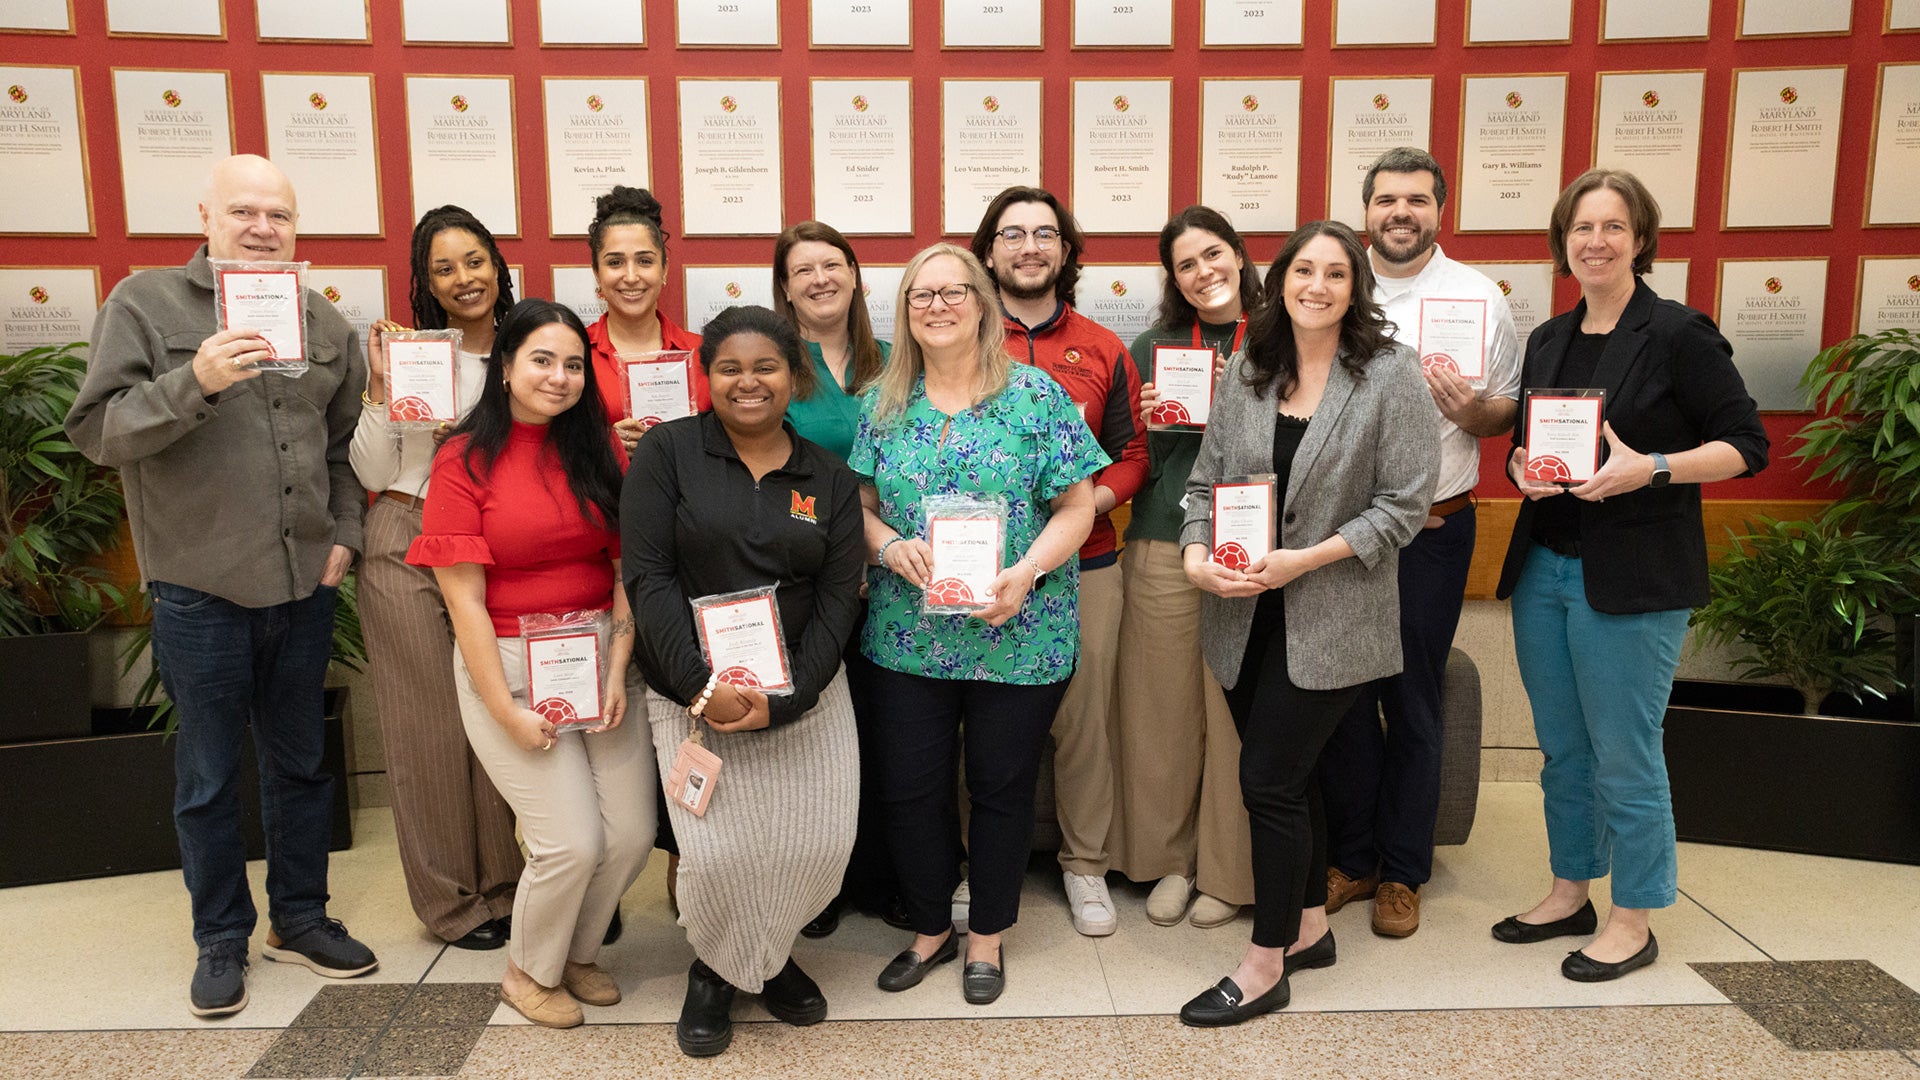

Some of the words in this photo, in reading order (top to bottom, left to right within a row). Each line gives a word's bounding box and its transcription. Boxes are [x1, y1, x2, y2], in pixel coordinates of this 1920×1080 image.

[0, 110, 51, 119] ARYLAND
[145, 113, 204, 123] MARYLAND
[1488, 115, 1540, 123] MARYLAND
[1623, 113, 1677, 122] MARYLAND
[1760, 111, 1816, 120] MARYLAND
[292, 117, 348, 125] MARYLAND
[434, 119, 488, 127] MARYLAND
[704, 119, 756, 127] MARYLAND
[1356, 117, 1407, 125] MARYLAND
[31, 124, 61, 133] SMITH
[138, 126, 170, 136] ROBERT
[184, 128, 212, 137] SMITH
[1480, 128, 1508, 136] ROBERT
[1521, 127, 1546, 135] SMITH
[1615, 127, 1644, 136] ROBERT
[1657, 126, 1682, 135] SMITH
[1752, 124, 1782, 133] ROBERT
[1795, 123, 1822, 132] SMITH
[285, 130, 316, 138] ROBERT
[330, 130, 357, 139] SMITH
[427, 132, 456, 140] ROBERT
[469, 132, 495, 140] SMITH
[605, 132, 631, 140] SMITH
[698, 132, 726, 140] ROBERT
[738, 132, 763, 140] SMITH
[829, 131, 857, 139] ROBERT
[869, 131, 894, 139] SMITH
[1090, 131, 1117, 139] ROBERT
[1258, 130, 1282, 138] SMITH
[1348, 130, 1376, 138] ROBERT
[1389, 129, 1413, 137] SMITH
[1887, 298, 1920, 306] MARYL
[12, 310, 71, 319] MARYLAND
[1737, 312, 1766, 321] ROBERT
[1780, 312, 1806, 320] SMITH
[1878, 311, 1909, 319] ROBERT
[5, 323, 37, 332] ROBERT
[52, 323, 80, 332] SMITH
[790, 489, 817, 519] M
[790, 514, 817, 525] ALUMNI
[715, 621, 765, 635] SMITHSATIONAL
[540, 656, 588, 666] SMITHSATIONAL
